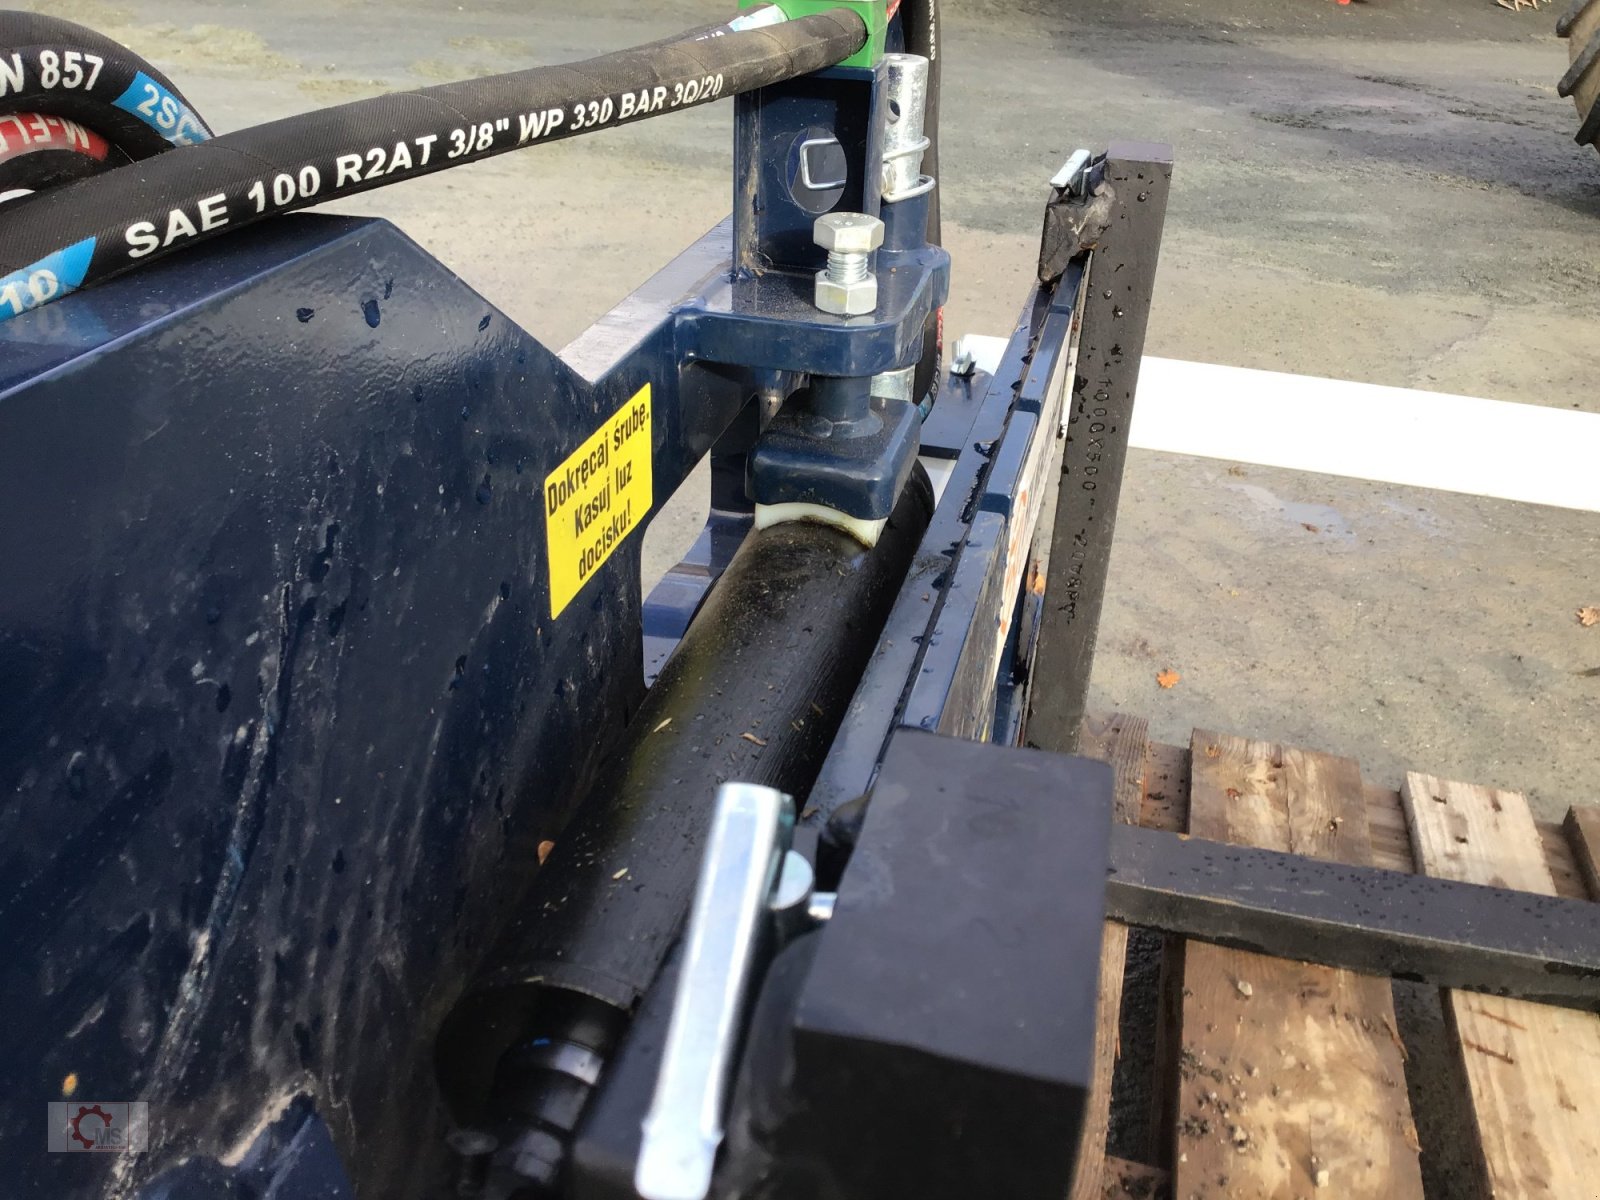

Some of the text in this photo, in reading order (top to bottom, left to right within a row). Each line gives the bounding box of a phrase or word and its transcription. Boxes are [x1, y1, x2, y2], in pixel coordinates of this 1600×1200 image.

[40, 50, 104, 91] 857
[125, 193, 230, 259] SAE
[247, 165, 321, 213] 100
[336, 134, 438, 188] R2AT
[448, 117, 510, 159] 3/8"
[518, 108, 565, 144] WP
[570, 97, 614, 131] 330
[618, 86, 668, 119] BAR
[670, 73, 724, 107] 3Q/20
[547, 402, 650, 517] Dokręcaj śrubę.
[574, 459, 633, 540] Kasuj luz
[578, 497, 632, 581] docisku!
